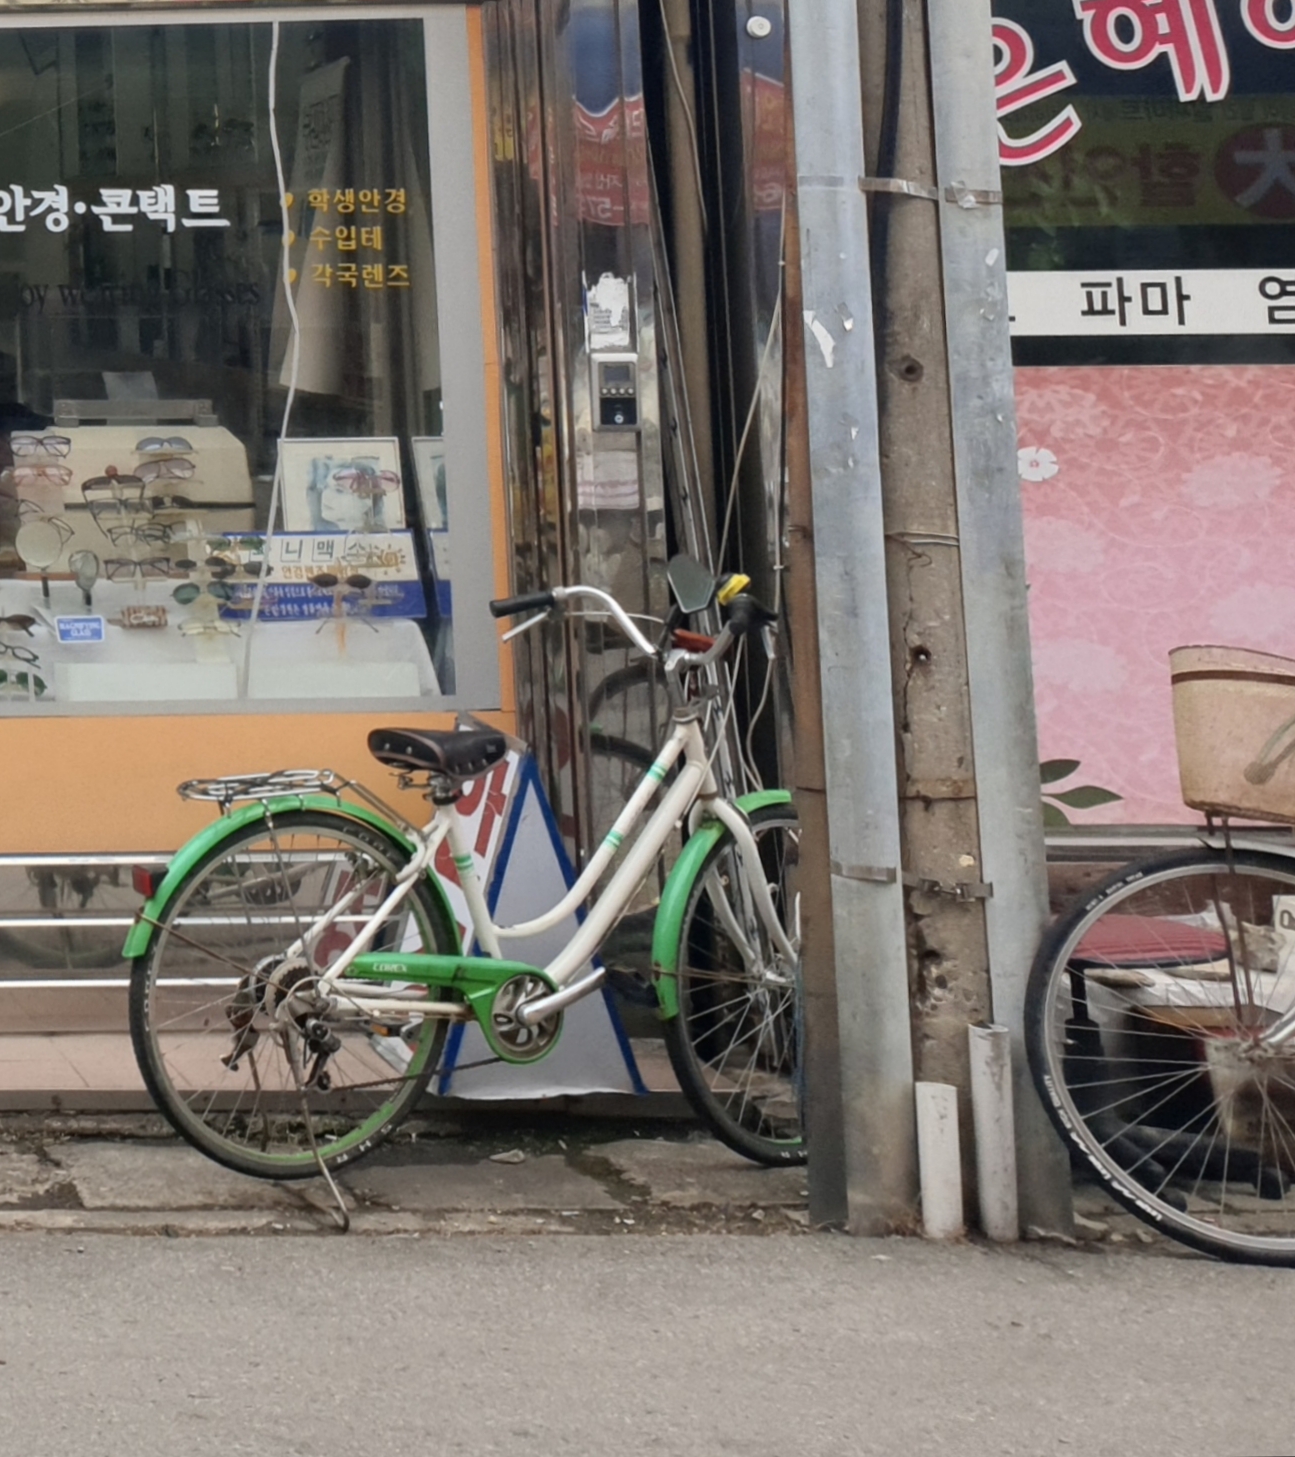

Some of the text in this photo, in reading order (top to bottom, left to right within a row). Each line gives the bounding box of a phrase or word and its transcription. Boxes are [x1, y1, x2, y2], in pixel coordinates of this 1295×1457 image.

[306, 187, 407, 214] 학생안경
[309, 225, 382, 251] 수입테
[310, 262, 411, 288] 각국렌즈
[1080, 275, 1192, 327] 파마
